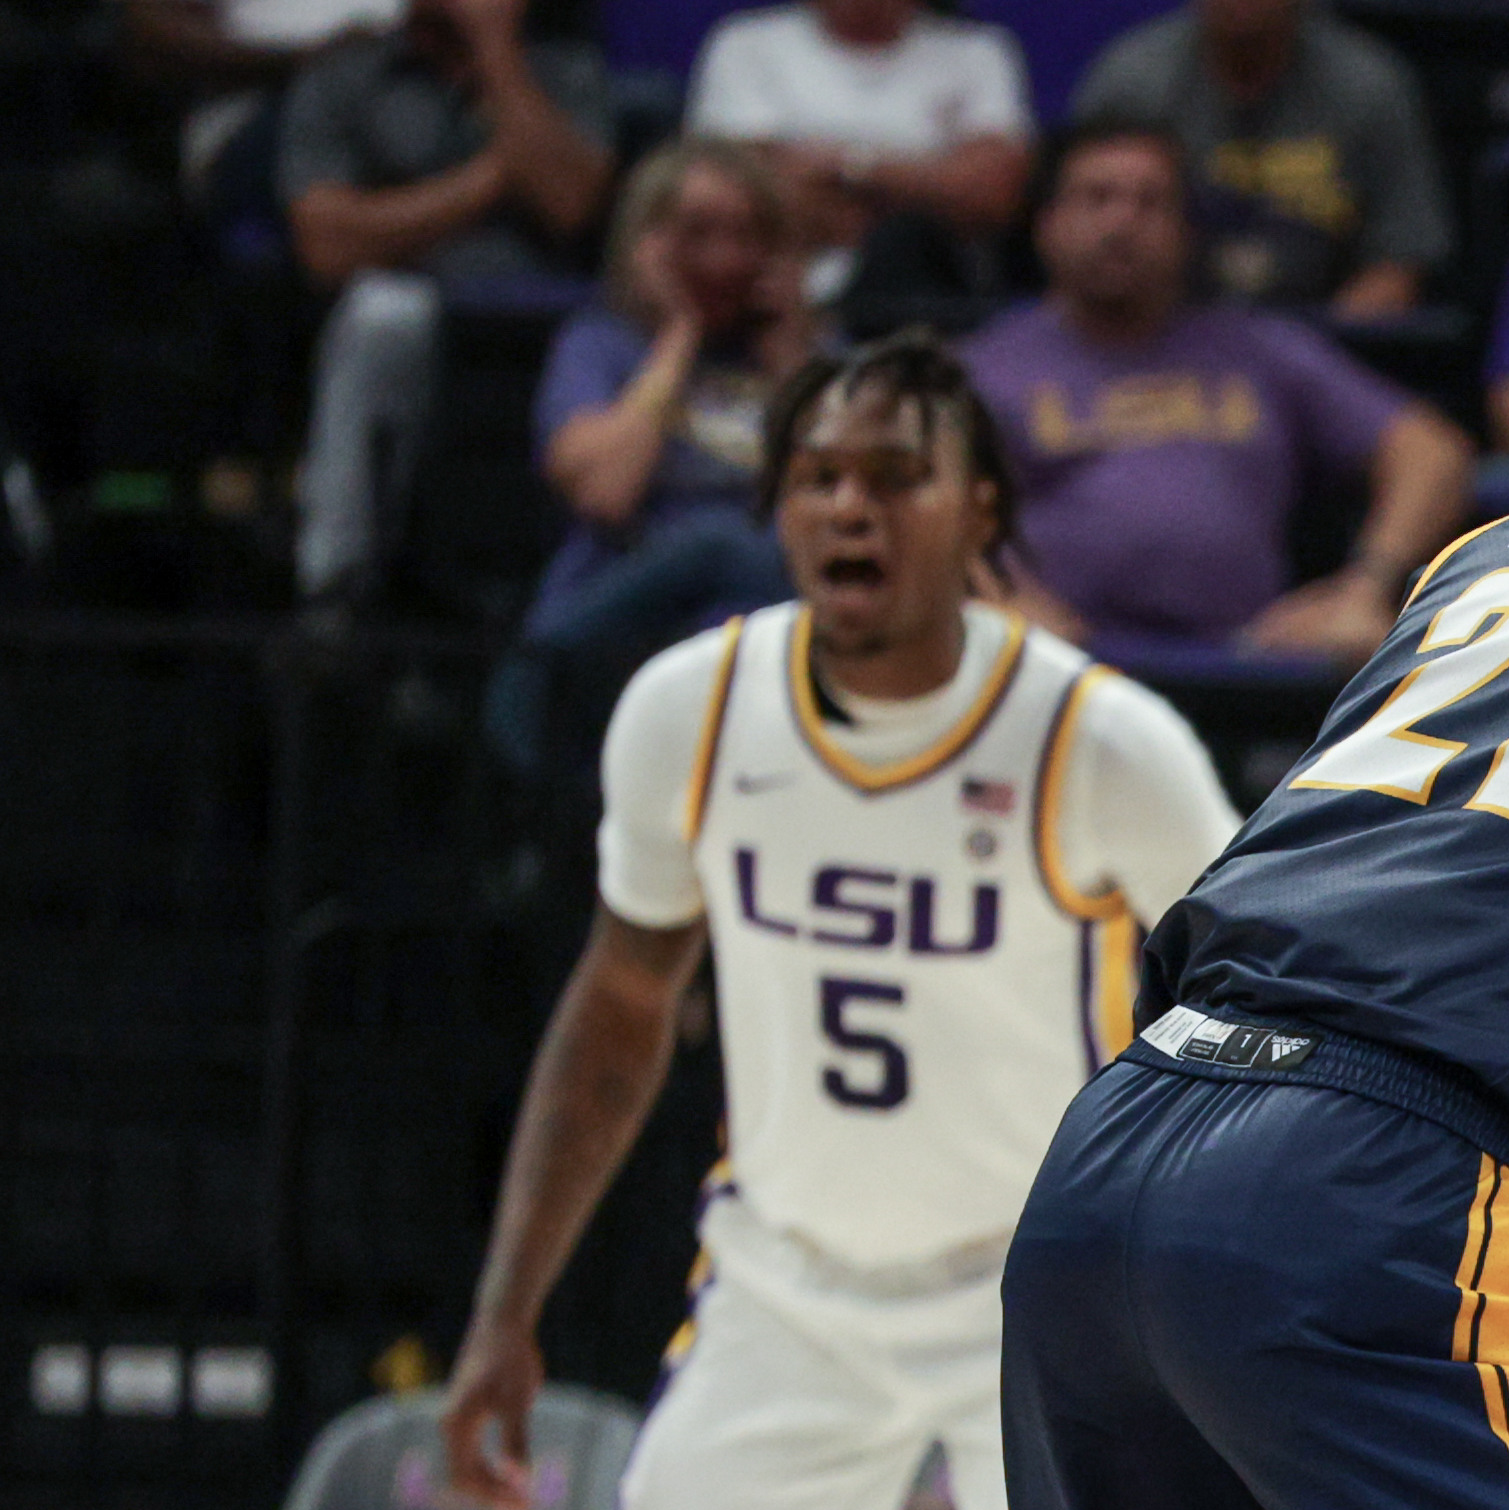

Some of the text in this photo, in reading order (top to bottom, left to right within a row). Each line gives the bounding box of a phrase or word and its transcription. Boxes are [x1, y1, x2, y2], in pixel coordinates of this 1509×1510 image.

[734, 846, 1001, 957] LSU
[819, 977, 911, 1114] 5
[1271, 1035, 1311, 1046] adidas
